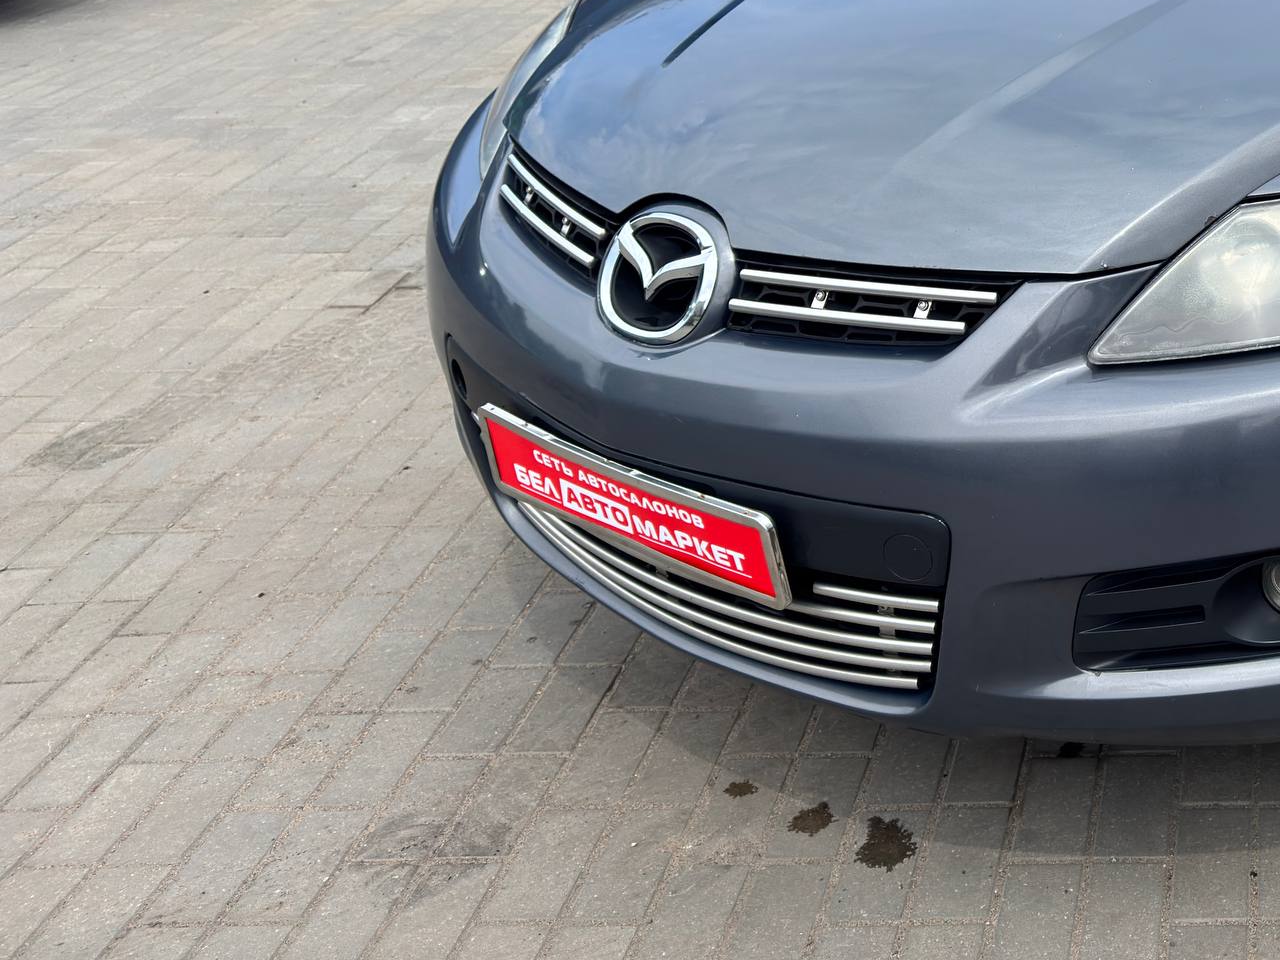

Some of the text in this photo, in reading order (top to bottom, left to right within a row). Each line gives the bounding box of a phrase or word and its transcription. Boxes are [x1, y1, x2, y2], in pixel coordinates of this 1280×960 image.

[513, 463, 746, 572] БЕЛ АВТО МАРКЕТ
[533, 449, 705, 529] СЕТЬ АВТОСАЛОНОВ
